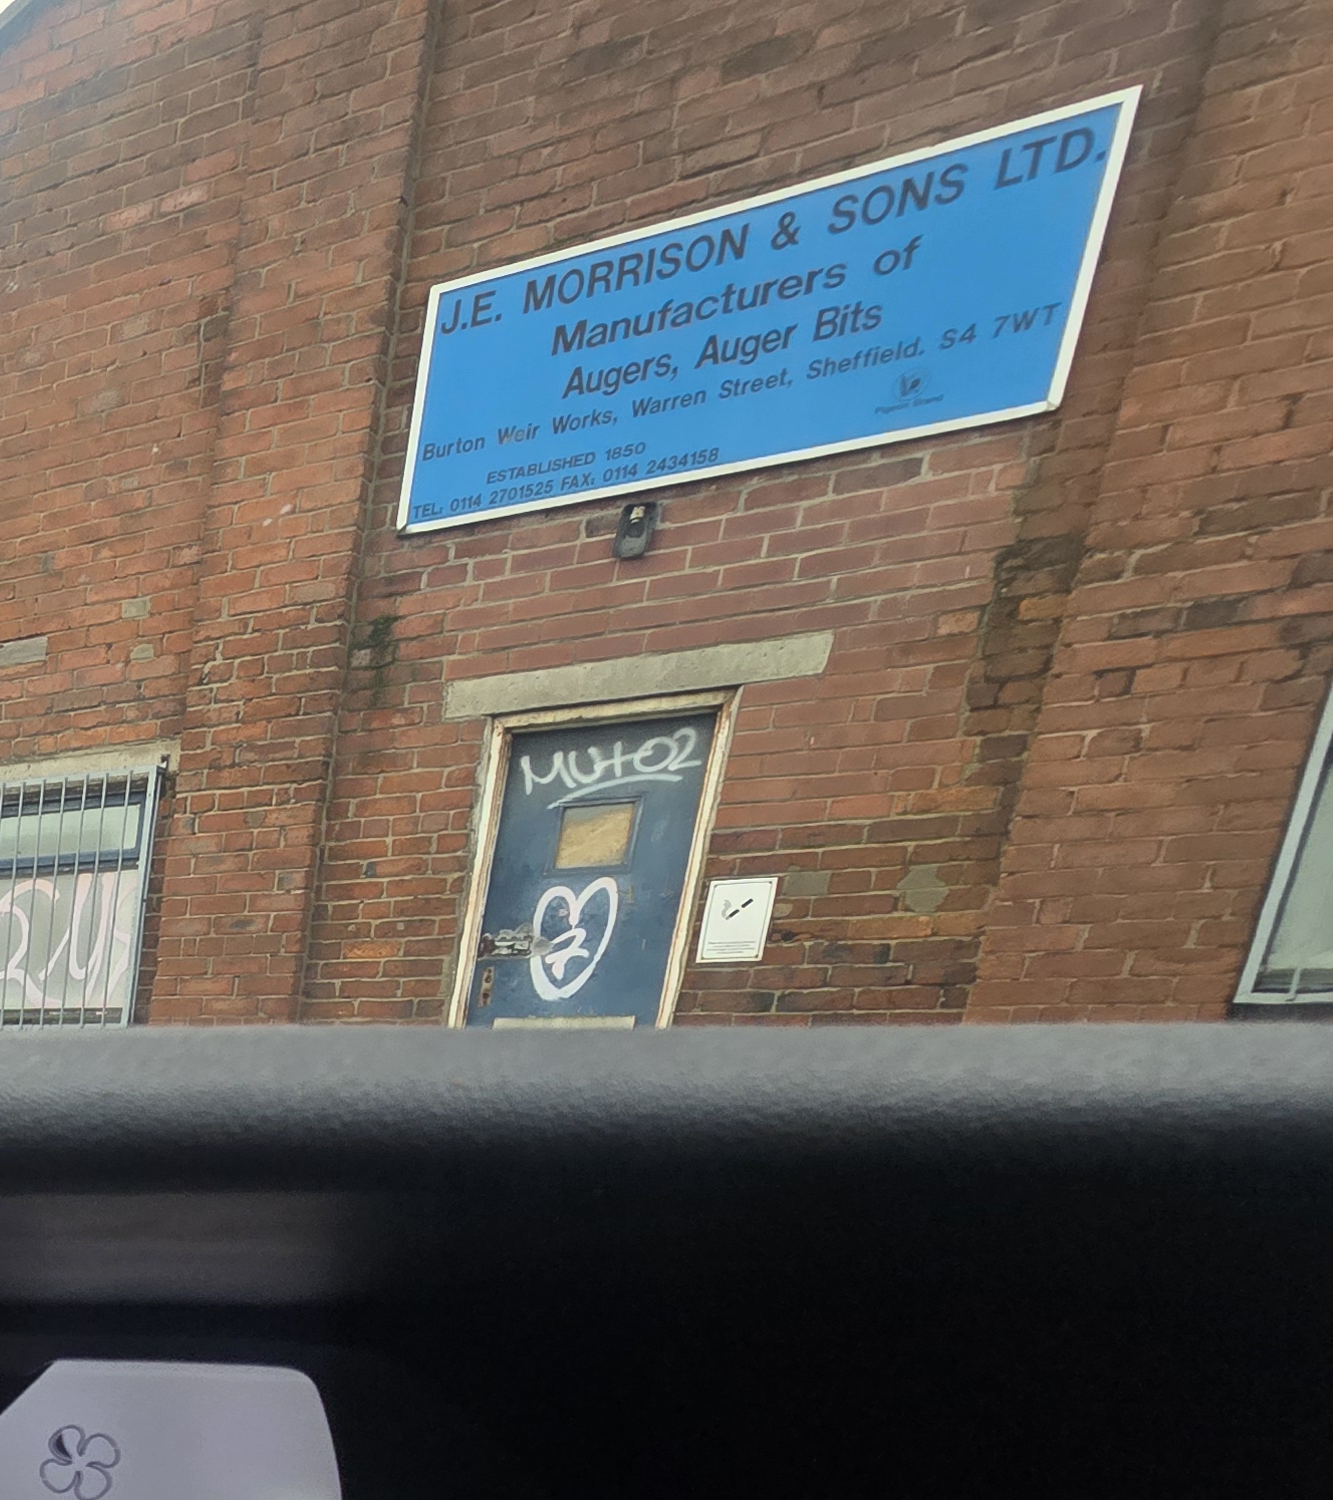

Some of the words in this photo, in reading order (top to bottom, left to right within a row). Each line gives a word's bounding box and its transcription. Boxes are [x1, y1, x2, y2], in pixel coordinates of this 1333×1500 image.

[441, 290, 502, 334] J.E.
[522, 222, 750, 314] MORRISON
[770, 211, 801, 250] &
[828, 163, 968, 235] SONS
[994, 126, 1106, 190] LTD.
[550, 262, 847, 356] Manufacturers
[873, 234, 924, 274] of
[562, 353, 679, 399] Augers,
[694, 323, 798, 369] Auger
[813, 301, 882, 342] Bits
[422, 434, 485, 461] Burton
[498, 423, 540, 446] Weir
[552, 409, 618, 435] Works,
[632, 389, 706, 418] Warren
[717, 367, 793, 400] Street,
[939, 323, 978, 351] S4
[992, 302, 1062, 339] 7WT
[450, 495, 482, 513] 0114
[489, 482, 554, 506] 2701525
[602, 464, 639, 484] 0114
[645, 447, 720, 475] 2434158
[486, 452, 596, 486] ESTABLISHED
[605, 441, 646, 461] 1850
